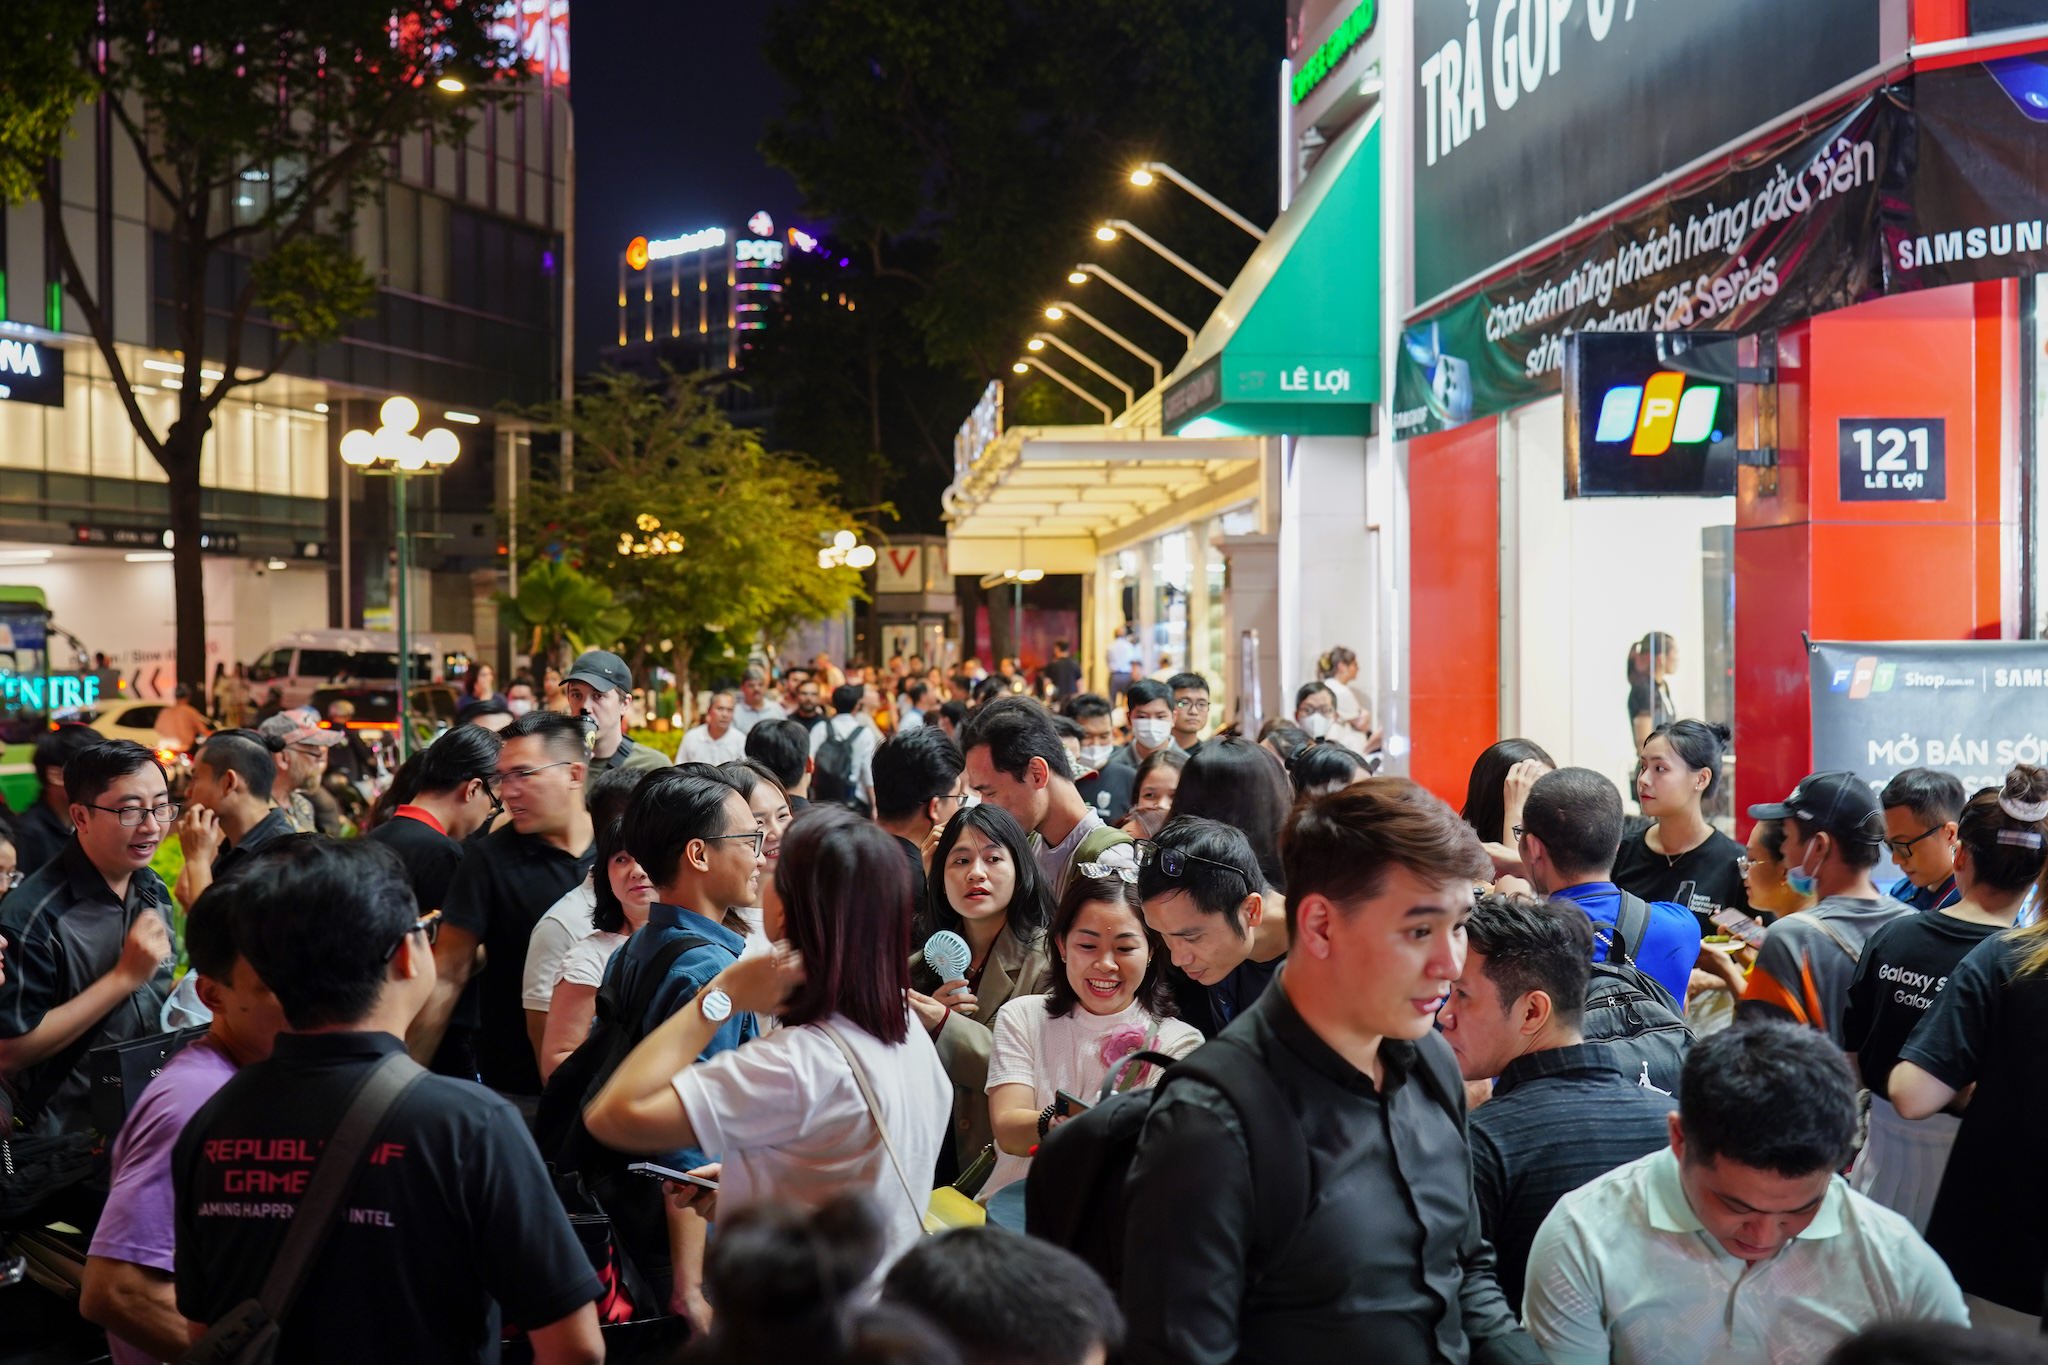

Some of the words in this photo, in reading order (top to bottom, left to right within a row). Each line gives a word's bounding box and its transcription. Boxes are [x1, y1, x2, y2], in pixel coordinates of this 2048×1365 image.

[1615, 227, 1681, 288] khách
[1684, 201, 1750, 260] hàng
[1751, 163, 1811, 229] đầu
[1898, 220, 2048, 270] SAMSUN
[1653, 280, 1694, 332] S25
[1695, 256, 1779, 319] Series
[1279, 366, 1309, 391] LÊ
[1313, 368, 1350, 395] LỢI
[1852, 427, 1929, 471] 121
[1864, 471, 1888, 489] LÊ
[1892, 472, 1924, 491] LỢI
[0, 674, 100, 710] ENTRE
[1867, 733, 1920, 766] MỞ
[1926, 733, 1989, 766] BÁN
[1995, 733, 2048, 766] SỚ
[1878, 963, 1935, 993] Galaxy
[204, 1138, 325, 1163] REPUBL
[349, 1208, 396, 1227] INTEL
